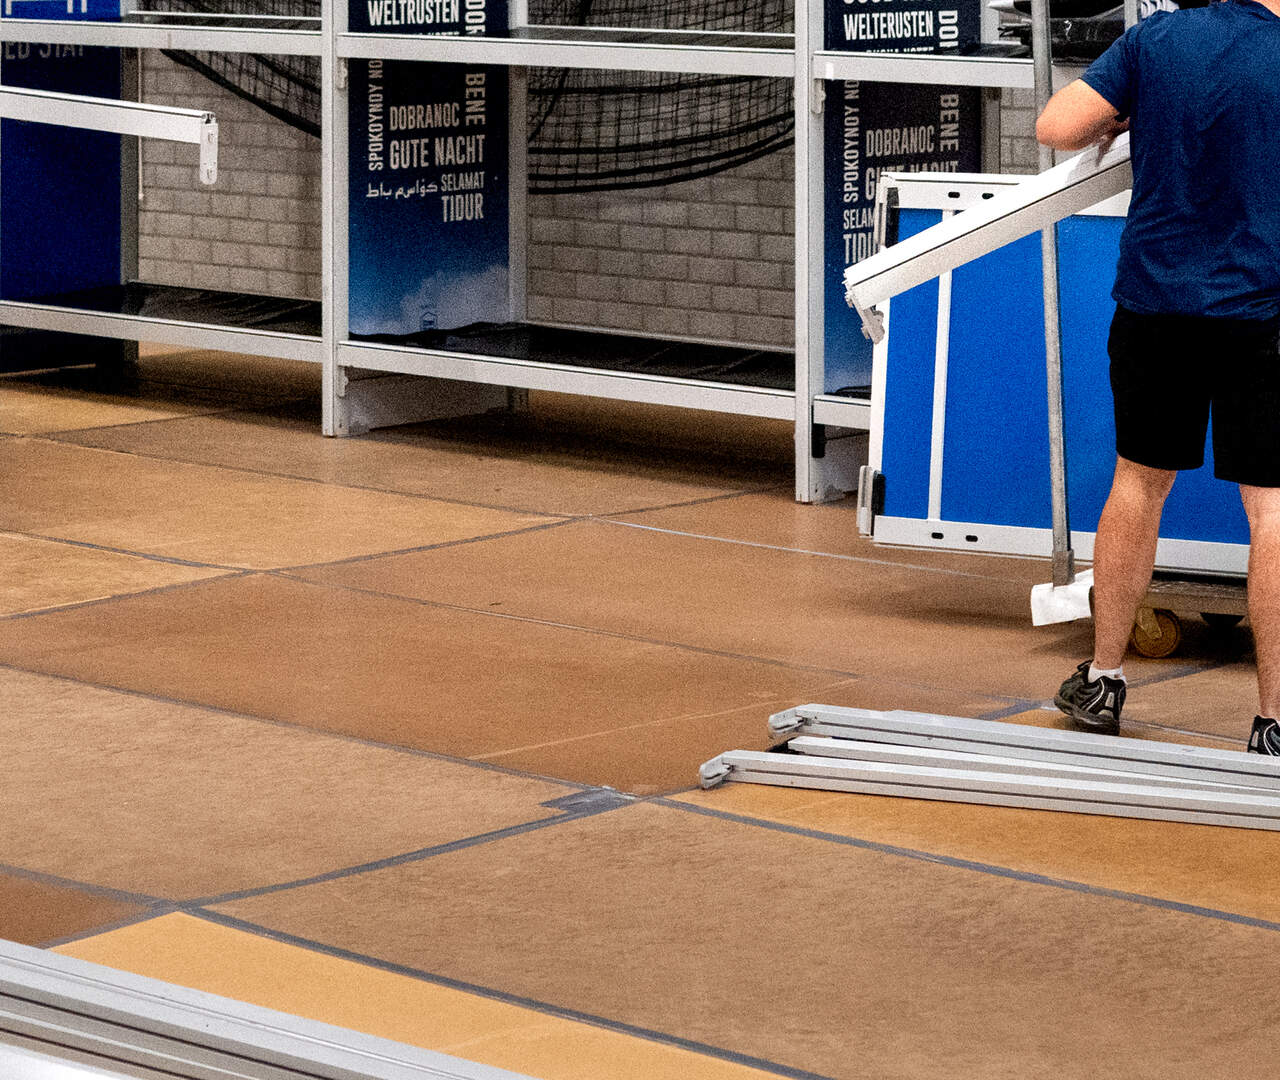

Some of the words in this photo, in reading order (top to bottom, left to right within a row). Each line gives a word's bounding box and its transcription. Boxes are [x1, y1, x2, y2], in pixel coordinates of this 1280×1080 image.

[844, 11, 933, 40] WELTERUSTEN
[465, 73, 486, 125] BENE
[368, 84, 383, 171] SPOKOYNOY
[390, 103, 460, 131] DOBRANOC
[940, 94, 959, 152] BENE
[390, 138, 429, 169] GUTE
[435, 135, 485, 166] NACHT
[843, 104, 859, 203] SPOKOYNOY
[866, 125, 934, 157] DOBRANOC
[441, 172, 485, 192] SELAMAT
[441, 193, 484, 222] TIDUR
